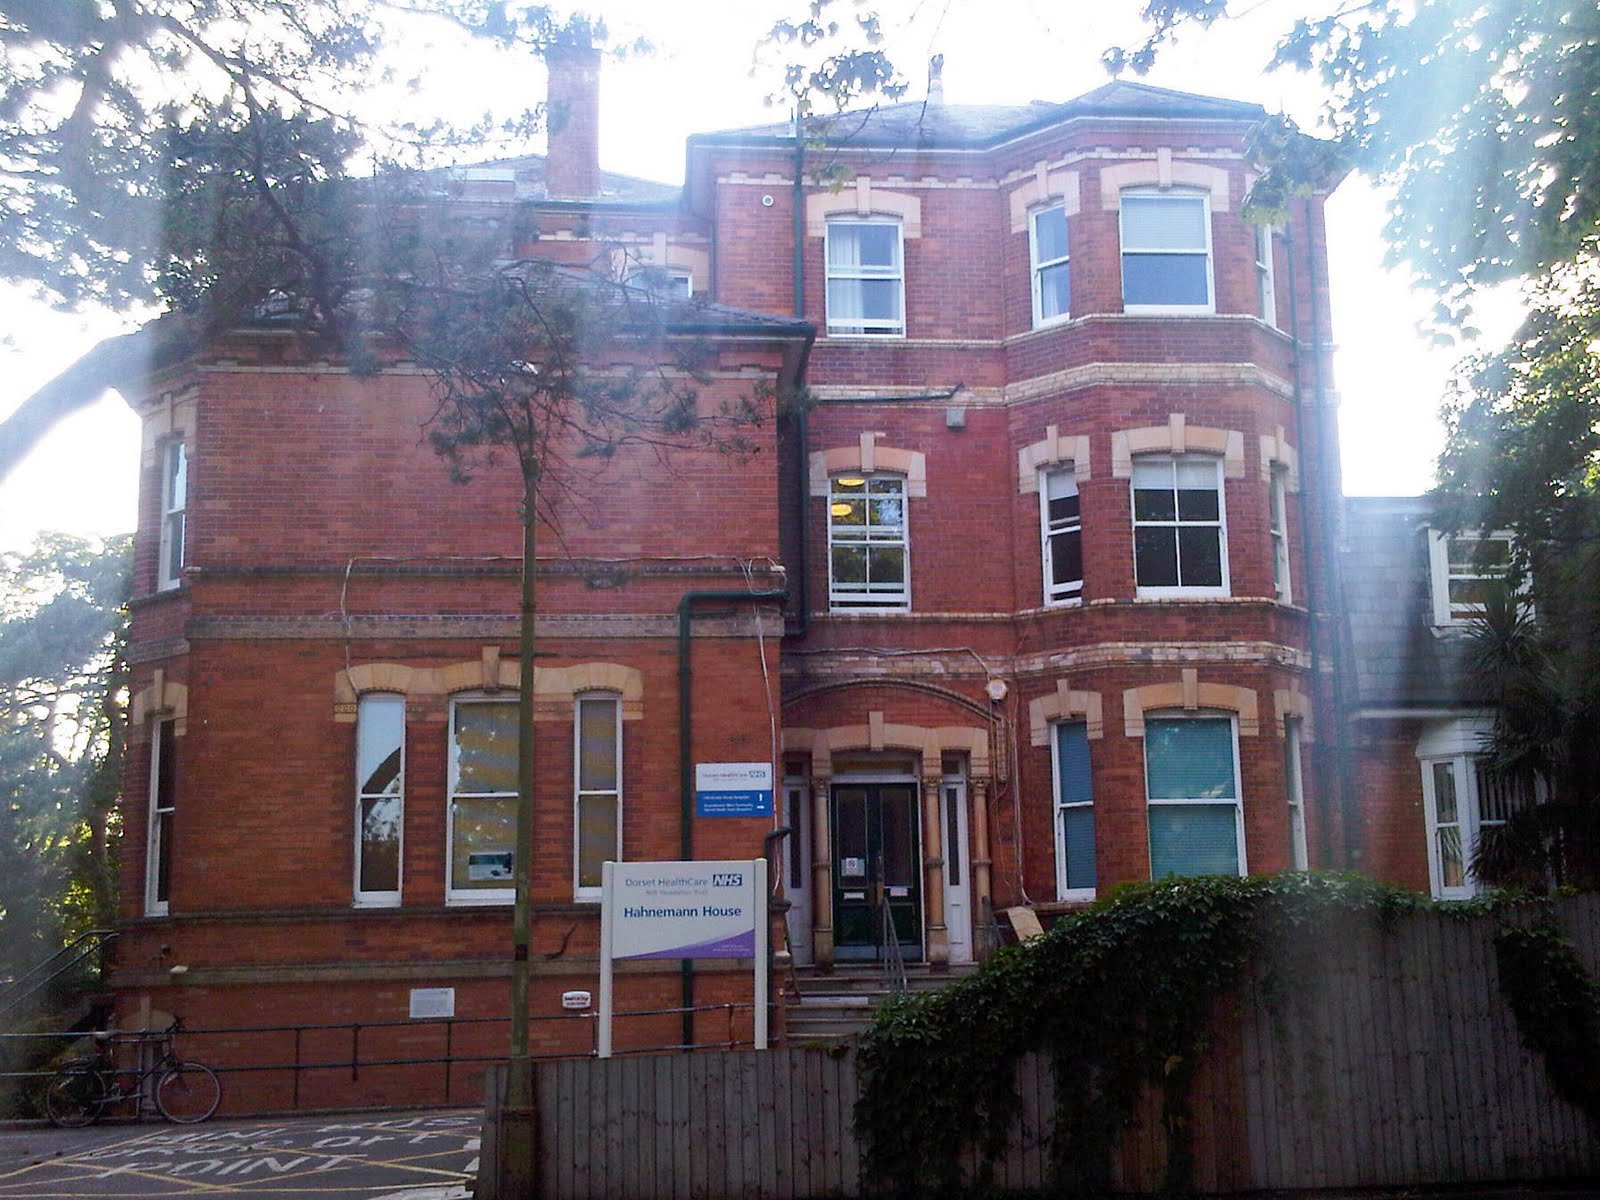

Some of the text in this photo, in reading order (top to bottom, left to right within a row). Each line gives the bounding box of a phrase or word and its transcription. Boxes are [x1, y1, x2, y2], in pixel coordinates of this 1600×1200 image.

[625, 874, 741, 887] Dorset HealthCare NHS
[624, 905, 742, 918] Hahnemann House
[96, 1153, 368, 1179] POINT
